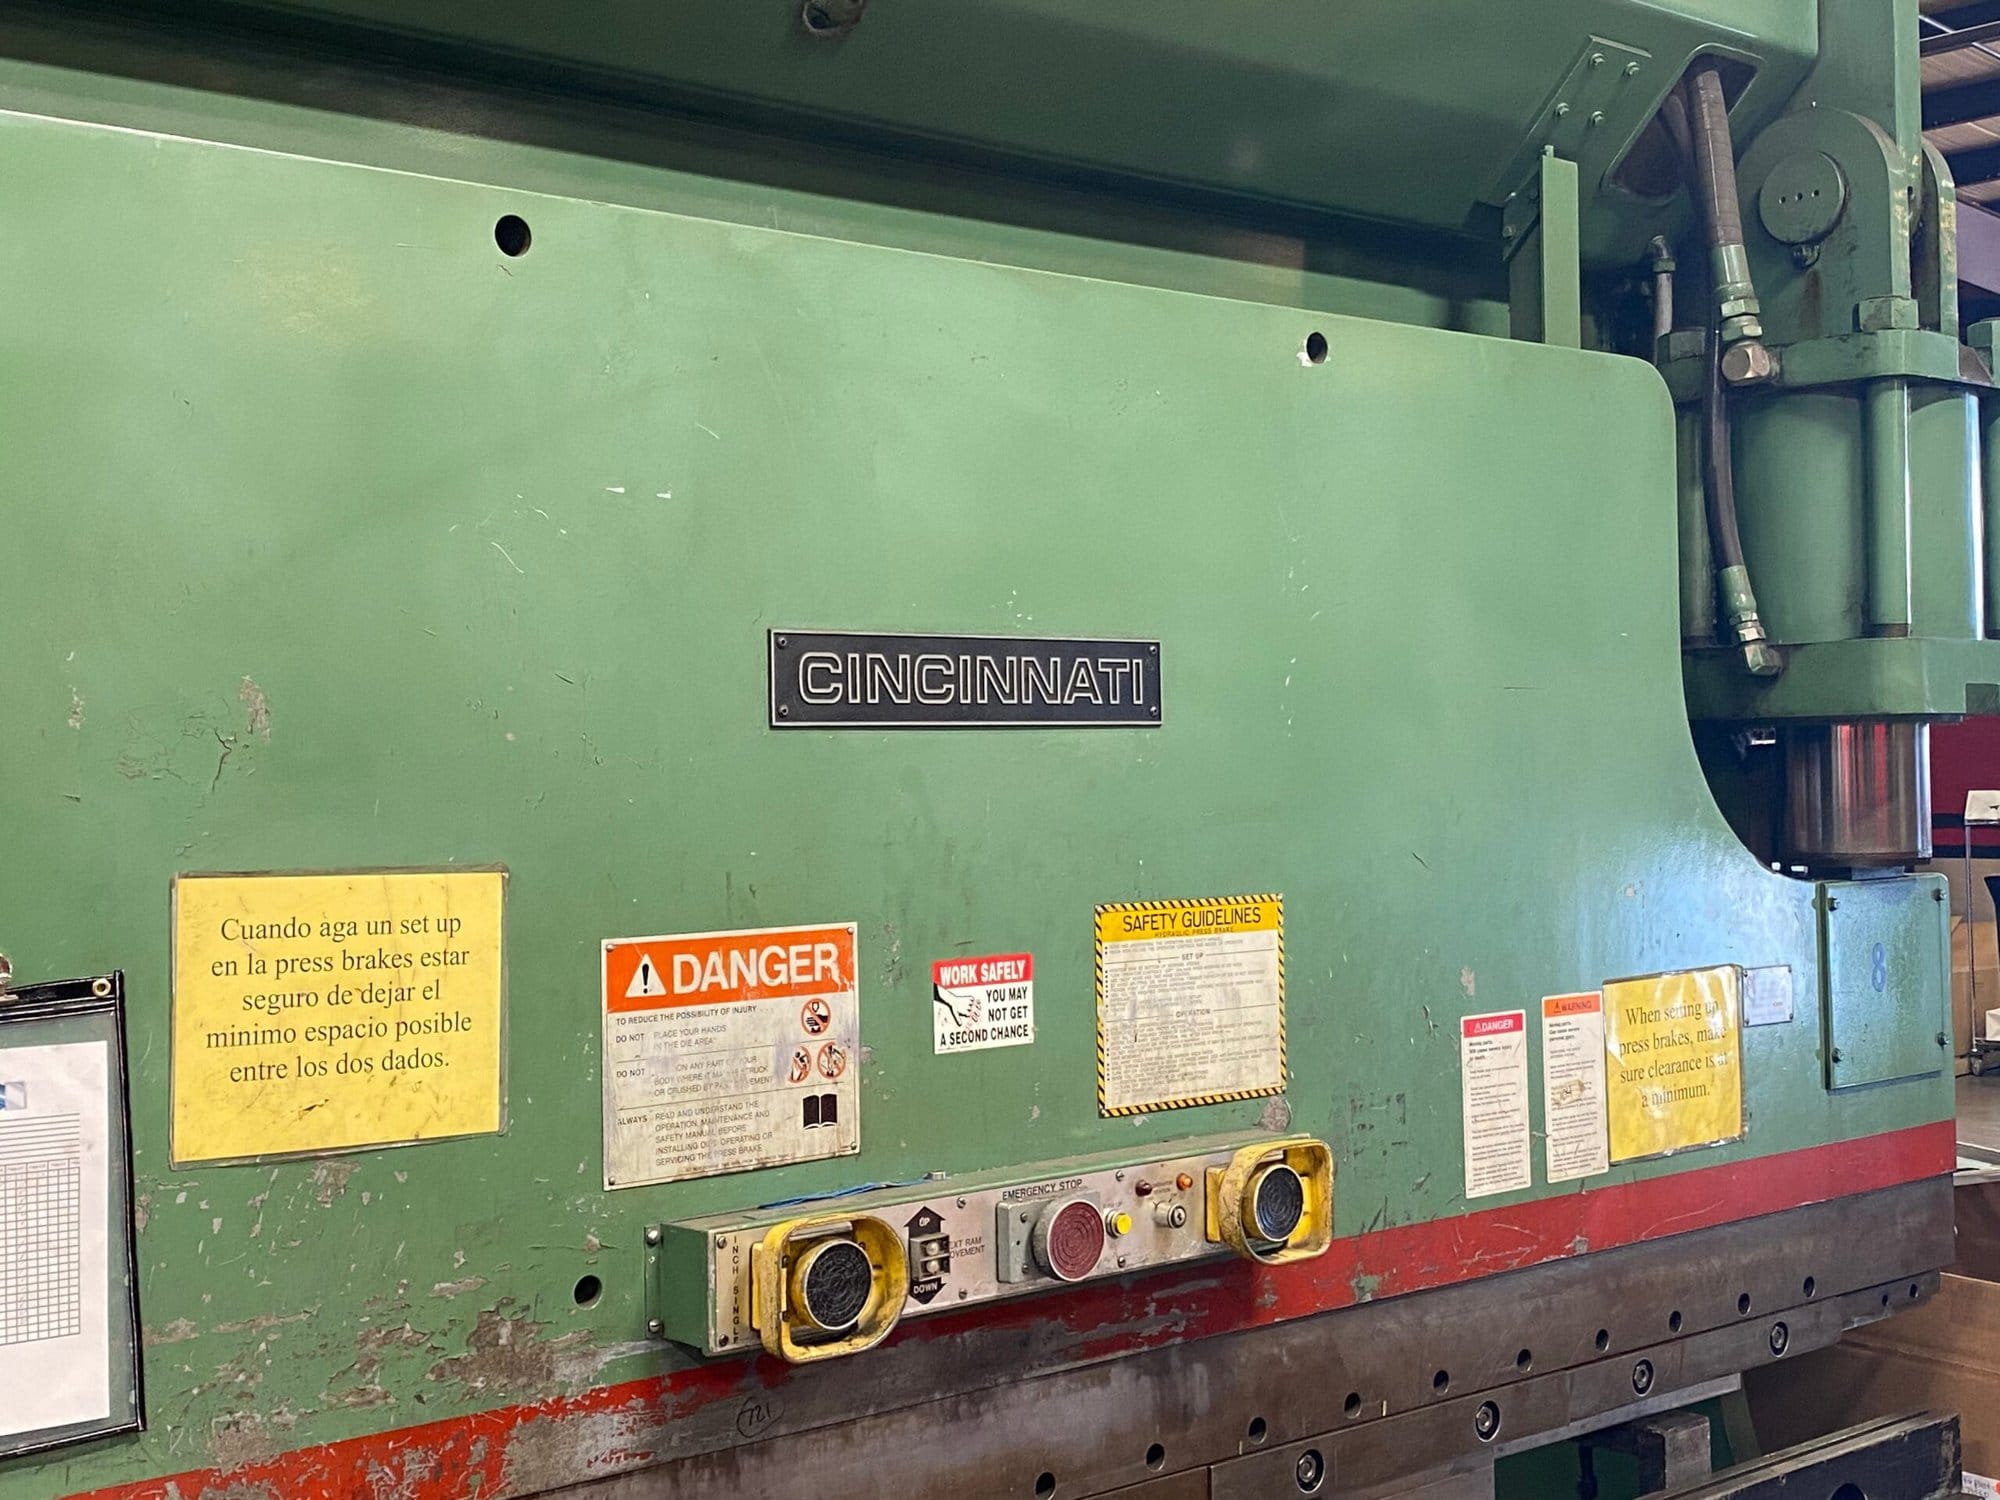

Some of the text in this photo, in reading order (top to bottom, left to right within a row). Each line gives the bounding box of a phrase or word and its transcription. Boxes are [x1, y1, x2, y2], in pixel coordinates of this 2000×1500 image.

[799, 651, 1144, 706] CINCINNATI
[221, 916, 461, 942] Cuando aga un set up
[1123, 907, 1262, 933] SAFETY GUIDELINES
[1155, 926, 1234, 938] HYDRAULIC PRESS BRAKE
[211, 948, 470, 980] en la press brakes estar
[1181, 952, 1204, 961] SET UP
[1872, 943, 1886, 992] 8
[673, 942, 841, 994] DANGER
[940, 960, 1026, 985] WORK SAFELY
[242, 979, 440, 1015] seguro de dejar el
[986, 986, 1028, 1003] YOU MAY
[628, 1015, 658, 1024] REDUCE
[660, 1013, 674, 1021] THE
[676, 1008, 718, 1019] POSSIBILITY
[720, 1007, 730, 1015] OF
[732, 1005, 757, 1014] INJURY
[989, 1005, 1028, 1022] NOT GET
[1625, 1007, 1660, 1025] When
[1704, 1000, 1718, 1019] up
[206, 1011, 472, 1048] minimo espacio posible
[616, 1025, 727, 1043] DO NOT PLACE YOUR HANDS
[940, 1024, 1029, 1046] A SECOND CHANCE
[1481, 1019, 1514, 1031] DANGER
[664, 1040, 678, 1048] THE
[680, 1038, 693, 1047] DIE
[694, 1037, 713, 1046] AREA
[1619, 1026, 1727, 1058] press brakes, make
[230, 1048, 449, 1082] entre los dos dados.
[616, 1070, 627, 1078] DO
[629, 1068, 645, 1077] NOT
[690, 1061, 704, 1070] ANY
[1620, 1066, 1644, 1084] sure
[1648, 1060, 1702, 1078] clearance
[1705, 1051, 1716, 1068] is
[654, 1088, 665, 1097] OR
[667, 1084, 702, 1096] CRUSHED
[1642, 1083, 1710, 1108] a minimum.
[616, 1100, 760, 1126] ALWAYS READ AND UNDERSTAND THE
[701, 1113, 753, 1126] MAINTENANCE
[754, 1110, 770, 1119] AND
[655, 1133, 683, 1144] SAFETY
[718, 1124, 747, 1135] BEFORE
[655, 1142, 699, 1155] INSTALLING
[720, 1134, 761, 1146] OPERATING
[762, 1131, 773, 1140] OR
[655, 1155, 696, 1167] SERVICING
[738, 1144, 762, 1154] BRAKE
[1002, 1179, 1082, 1200] EMERGENCY STOP
[919, 1217, 930, 1227] UP
[949, 1236, 982, 1249] EXT RAM
[949, 1245, 985, 1258] OVEMENT
[913, 1282, 938, 1294] DOWN
